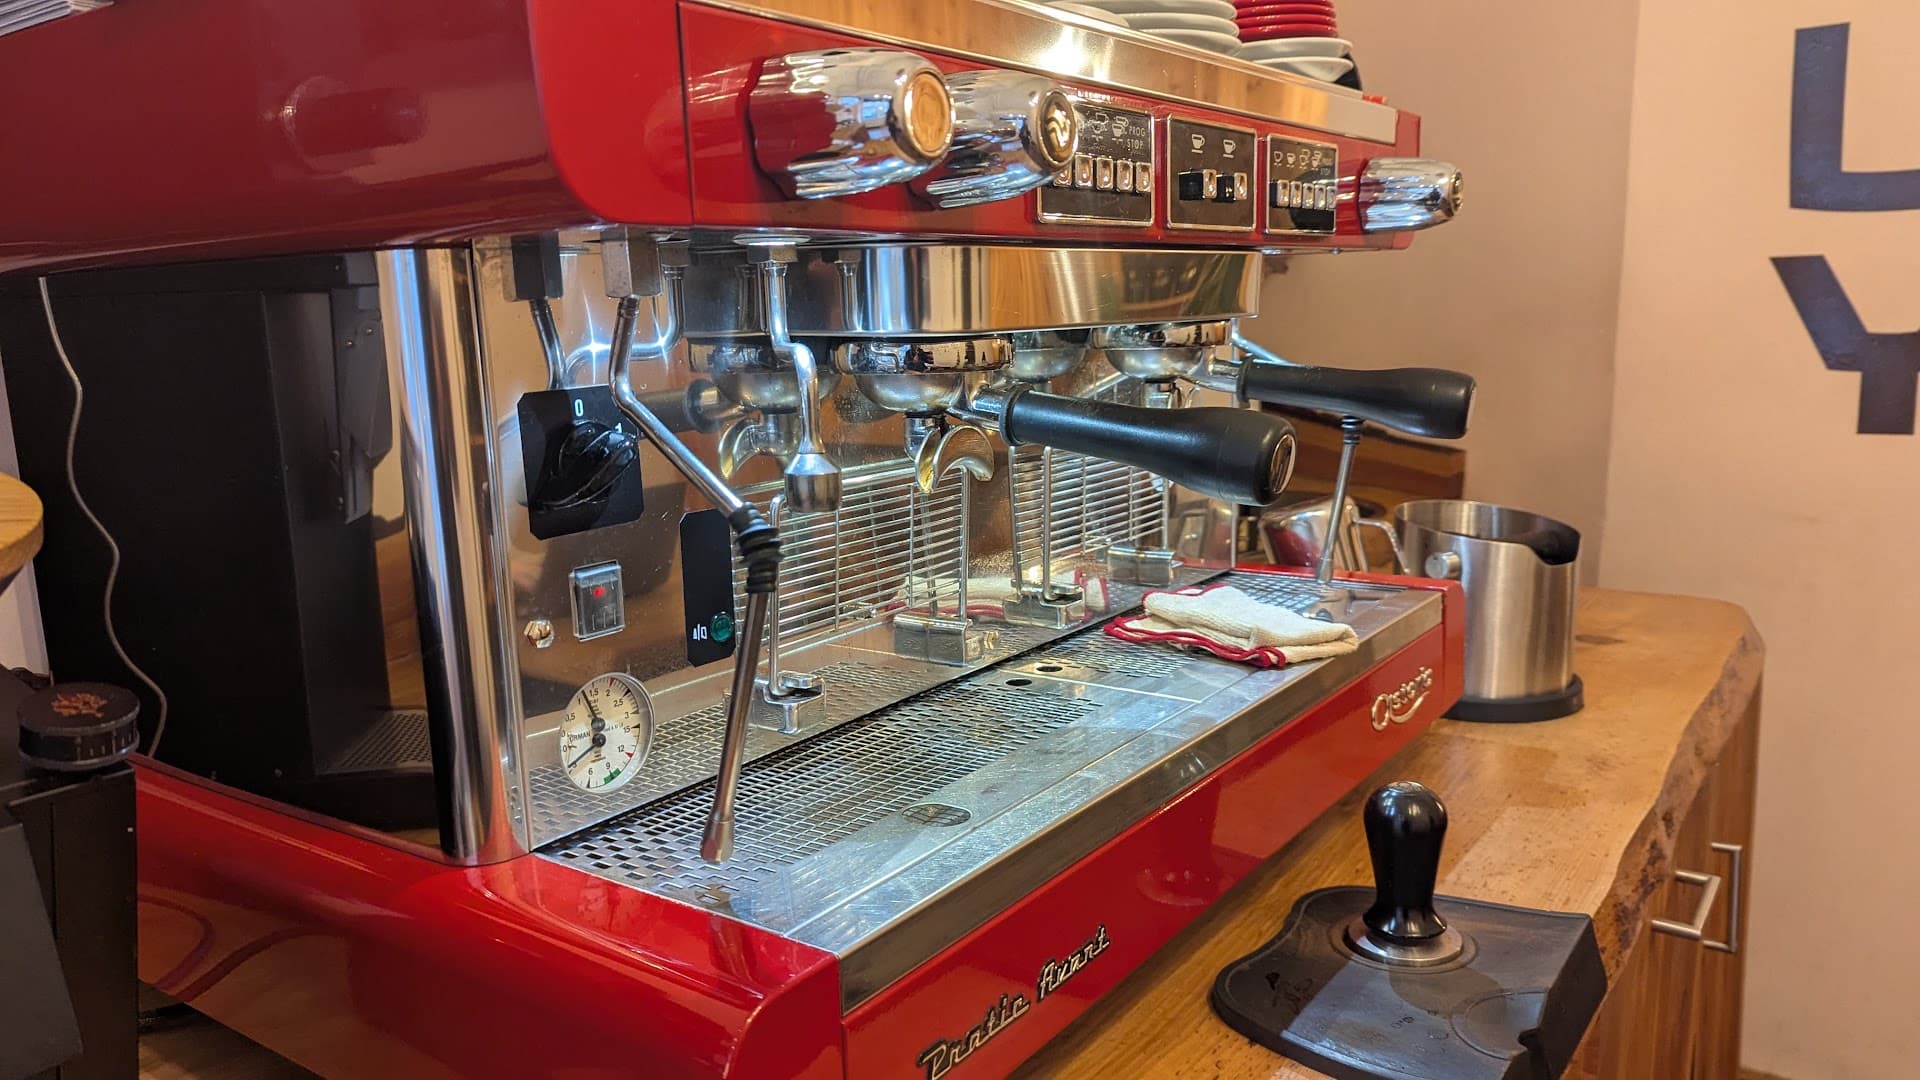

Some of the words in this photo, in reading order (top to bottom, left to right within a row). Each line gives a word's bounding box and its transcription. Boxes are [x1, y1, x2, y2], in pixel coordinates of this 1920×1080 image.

[1129, 126, 1146, 137] PROG
[1127, 138, 1144, 149] STOP
[575, 399, 584, 417] 0
[605, 689, 611, 697] 2
[617, 744, 625, 753] 12
[917, 994, 1031, 1080] Pratic
[1036, 924, 1110, 1001] Avant
